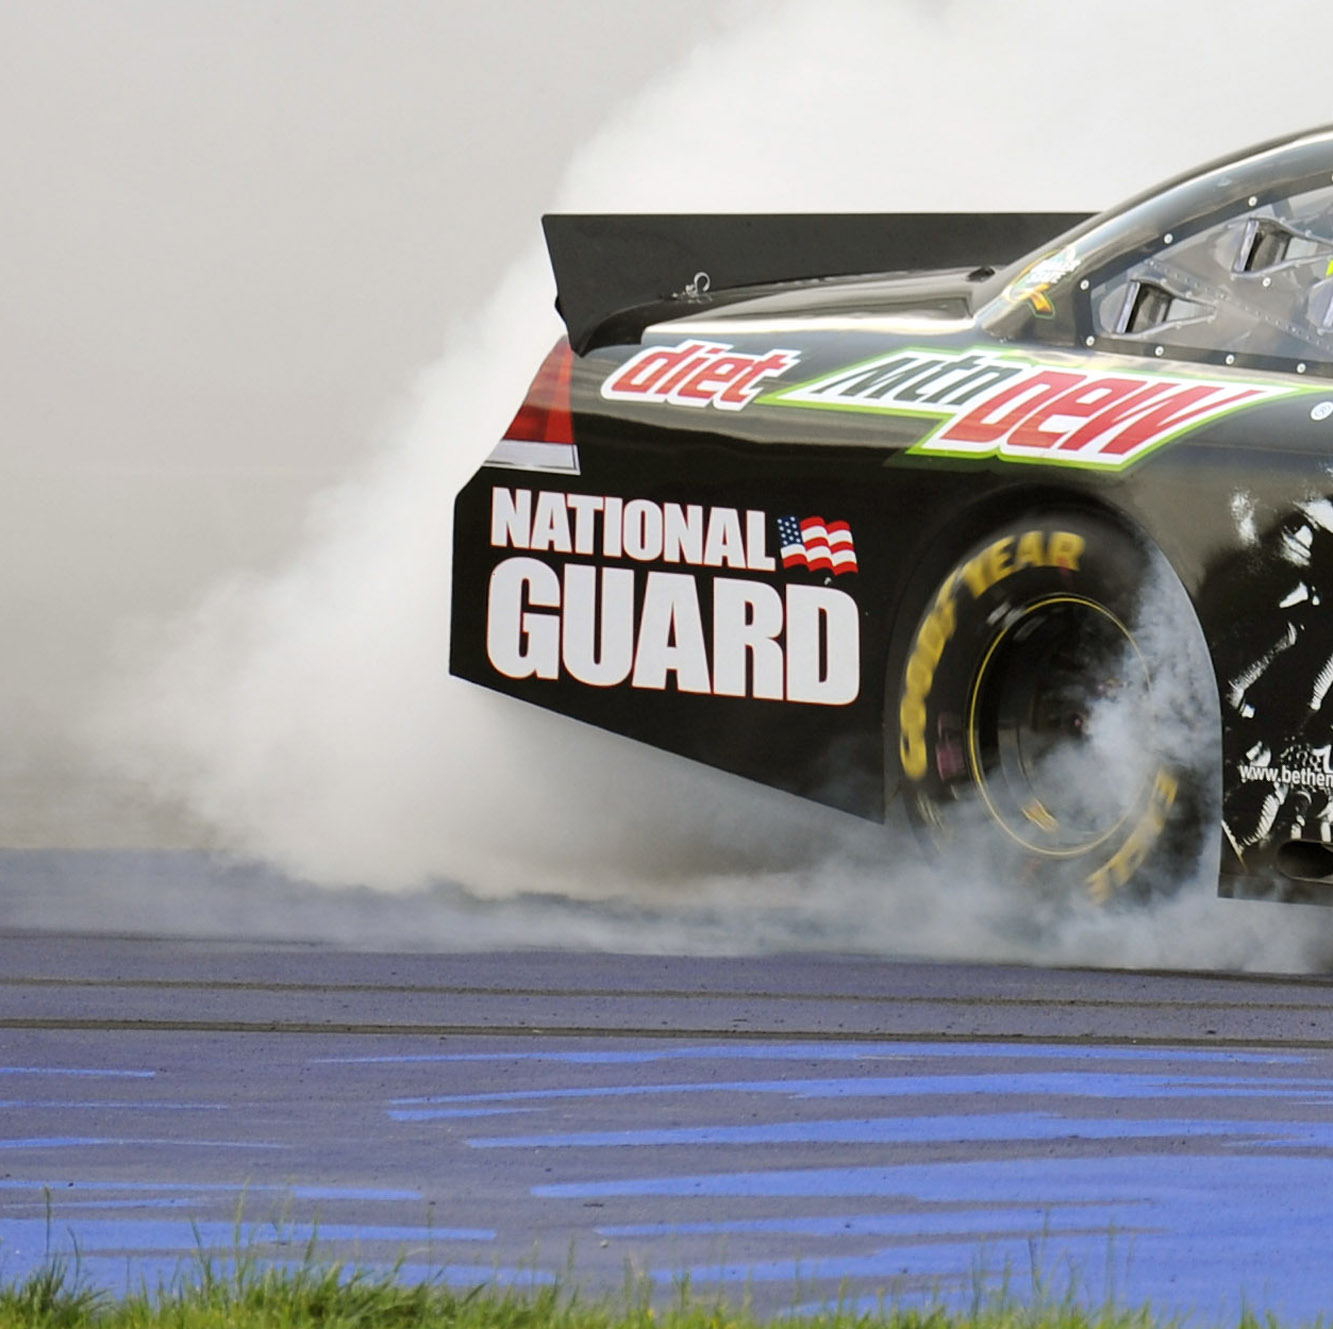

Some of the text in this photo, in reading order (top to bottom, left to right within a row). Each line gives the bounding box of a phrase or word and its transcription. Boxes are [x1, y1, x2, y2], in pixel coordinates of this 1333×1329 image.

[605, 340, 799, 408] diet
[490, 486, 777, 572] NATIONAL
[486, 556, 860, 706] GUARD
